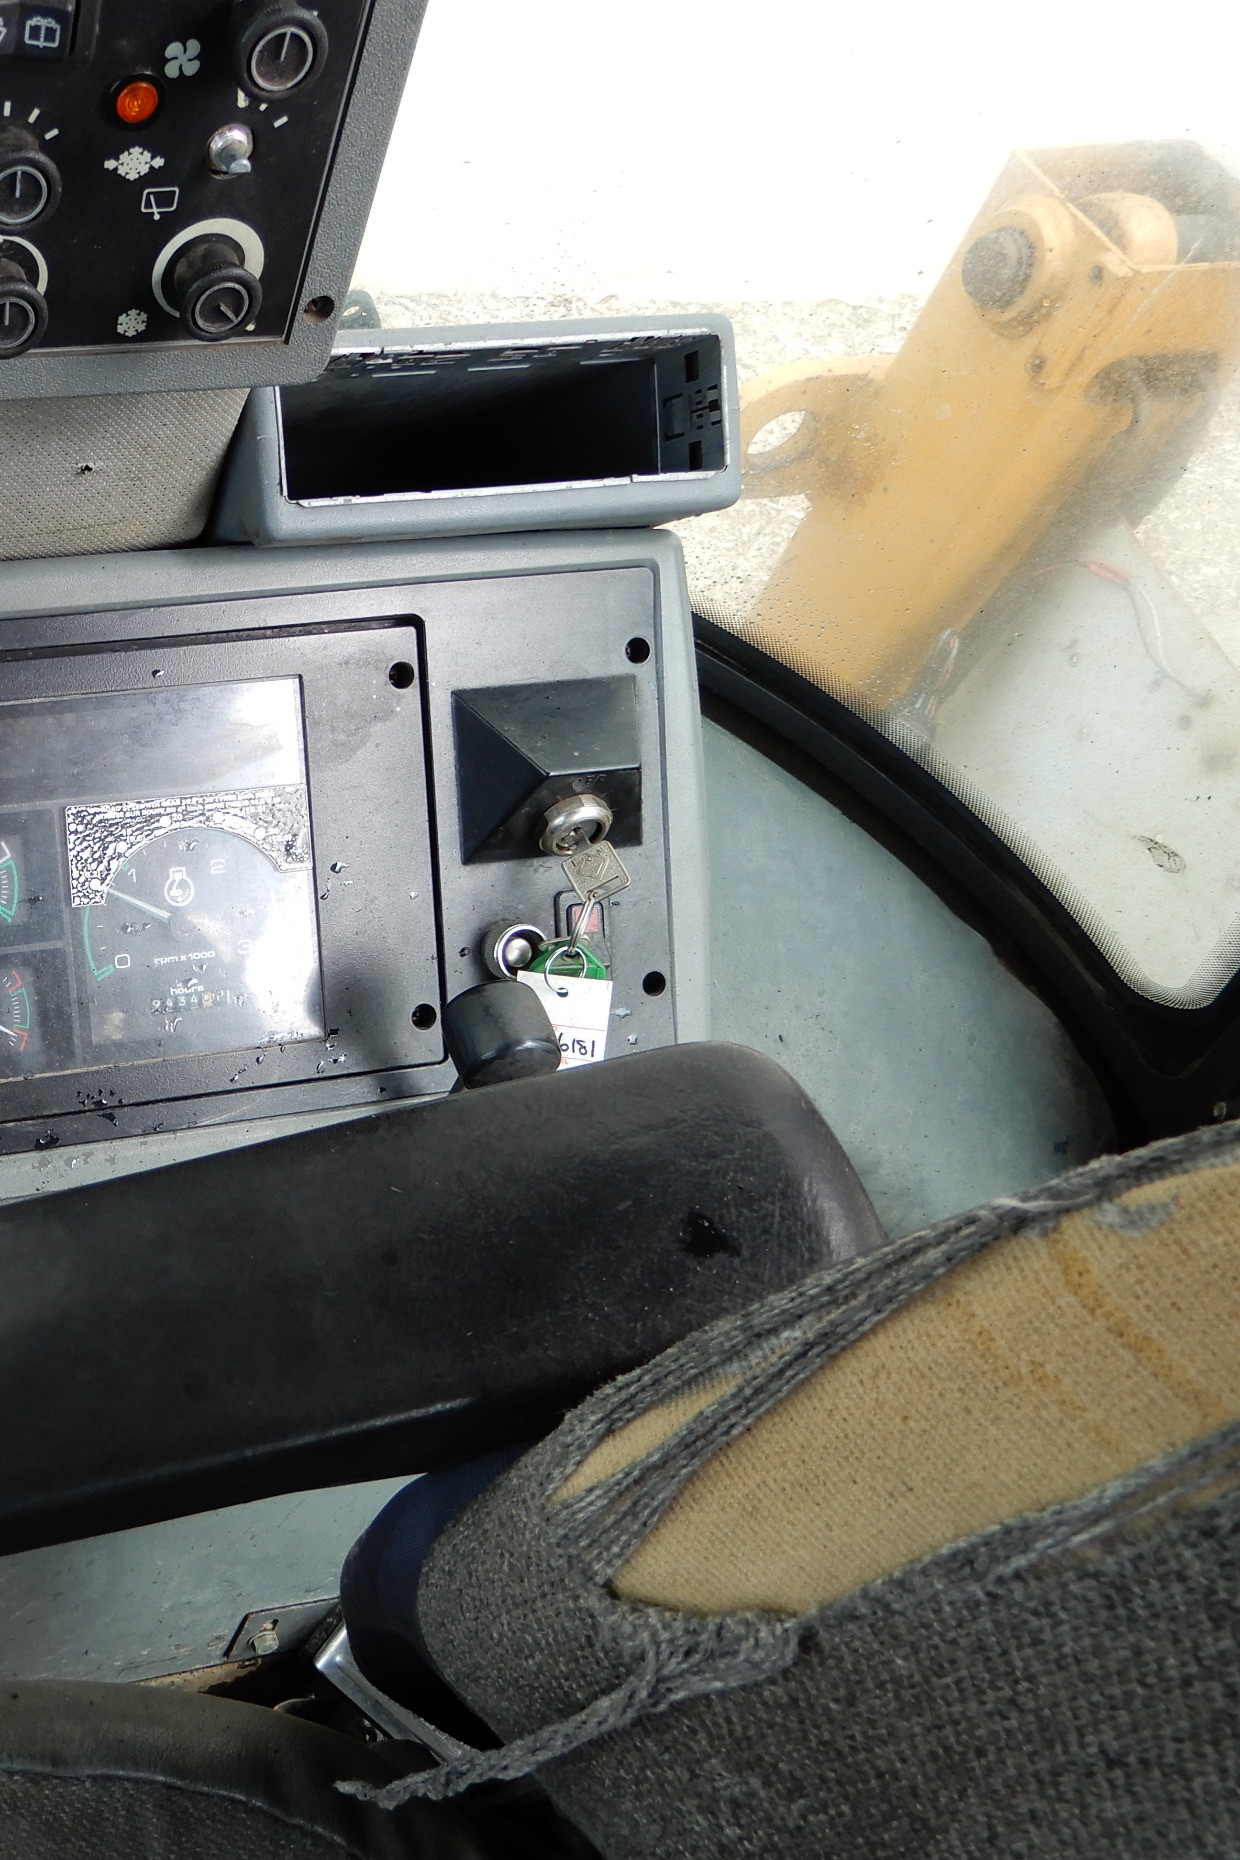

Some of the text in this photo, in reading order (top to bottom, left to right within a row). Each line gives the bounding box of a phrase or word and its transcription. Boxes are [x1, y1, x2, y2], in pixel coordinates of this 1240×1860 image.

[210, 859, 226, 874] 2
[127, 868, 137, 882] 1
[115, 953, 130, 968] 0
[154, 956, 178, 965] rpm
[187, 950, 215, 961] 1000
[170, 985, 204, 995] hours
